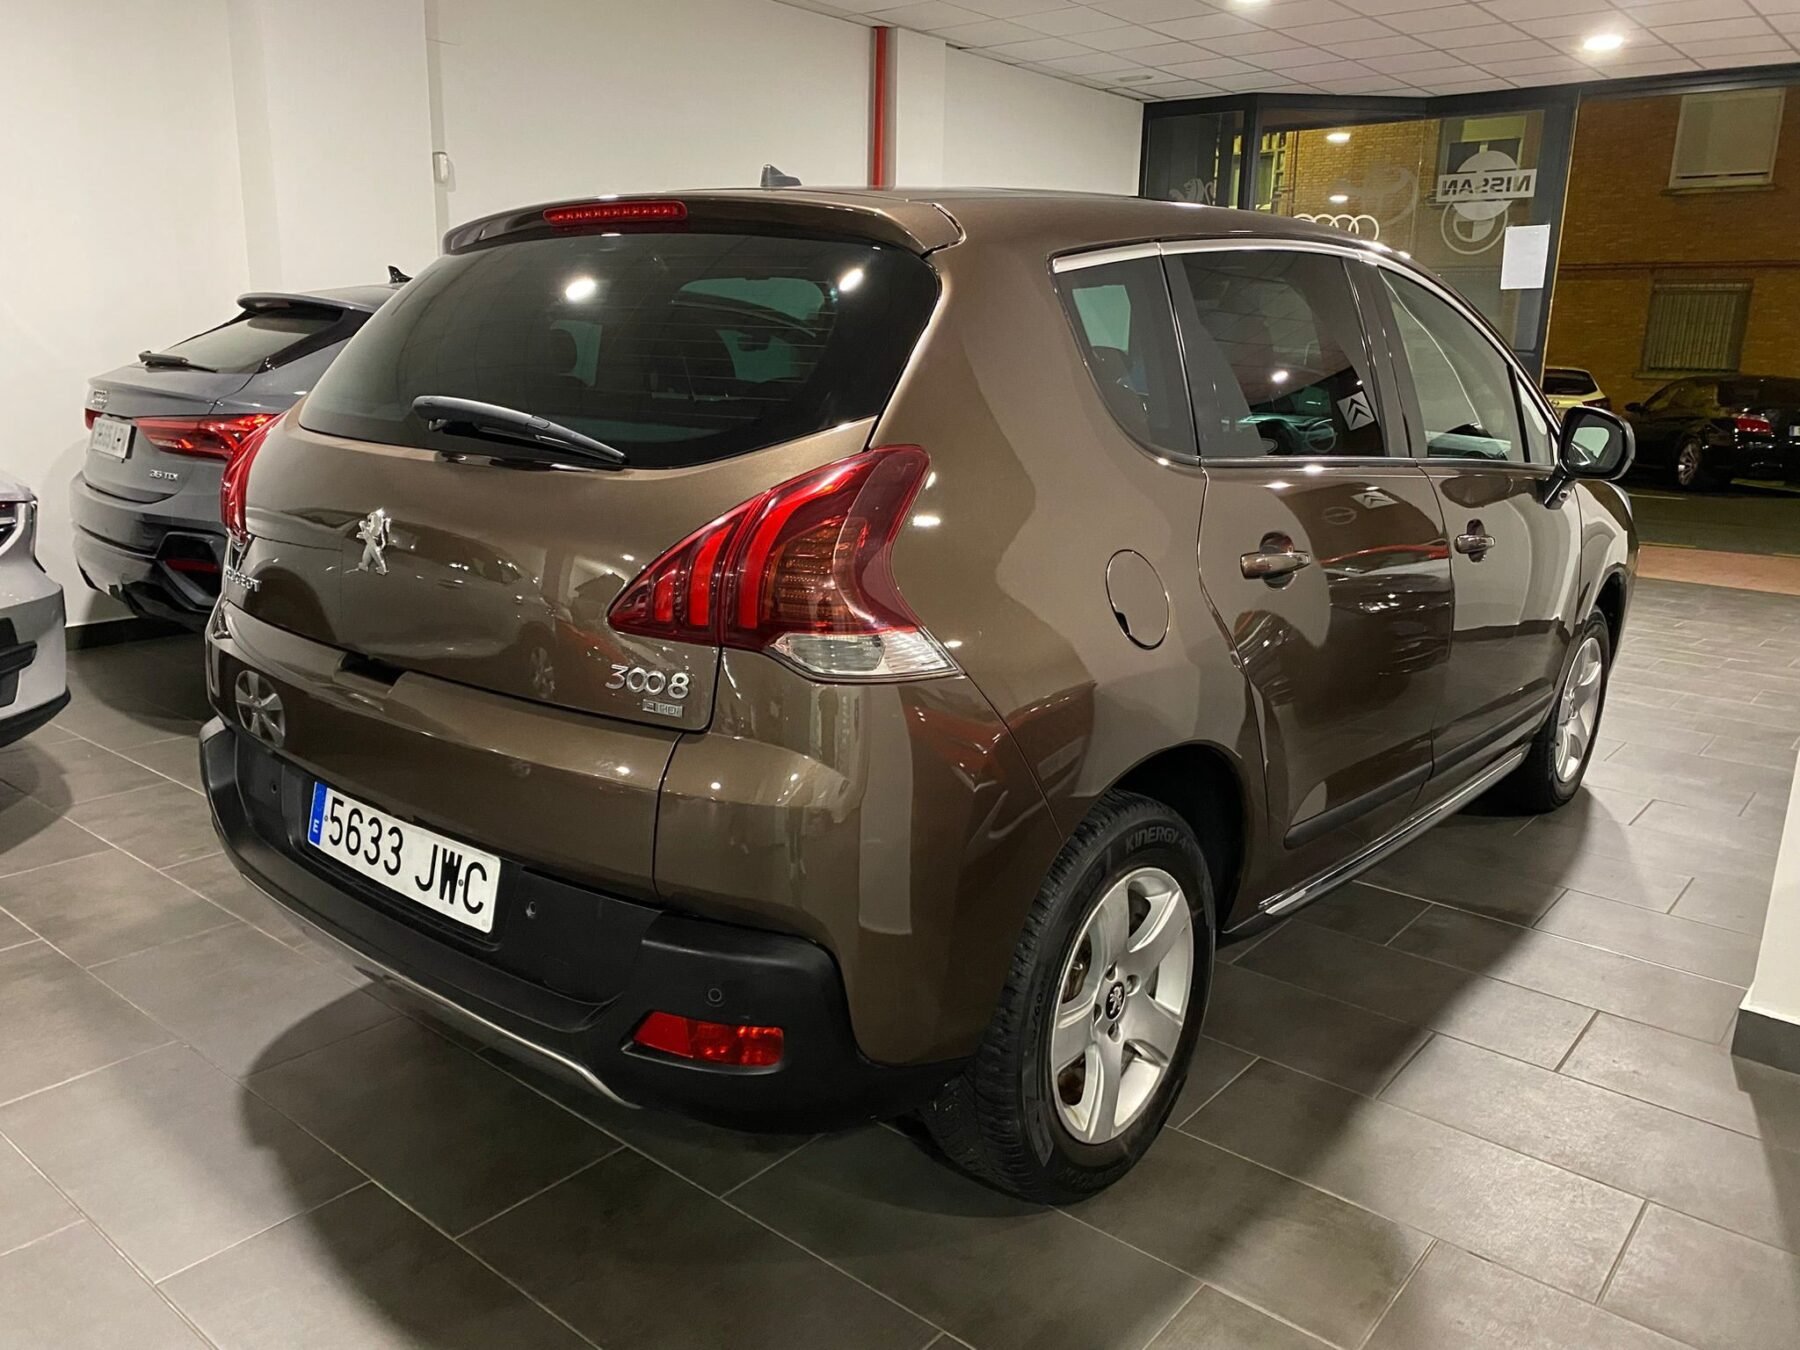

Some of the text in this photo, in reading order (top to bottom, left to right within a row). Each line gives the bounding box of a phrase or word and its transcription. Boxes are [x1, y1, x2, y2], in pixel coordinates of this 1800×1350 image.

[163, 471, 179, 481] TDI
[604, 663, 690, 699] 3008
[313, 819, 320, 833] E
[1125, 825, 1179, 854] KINERGY
[328, 796, 488, 914] 5633 JWC
